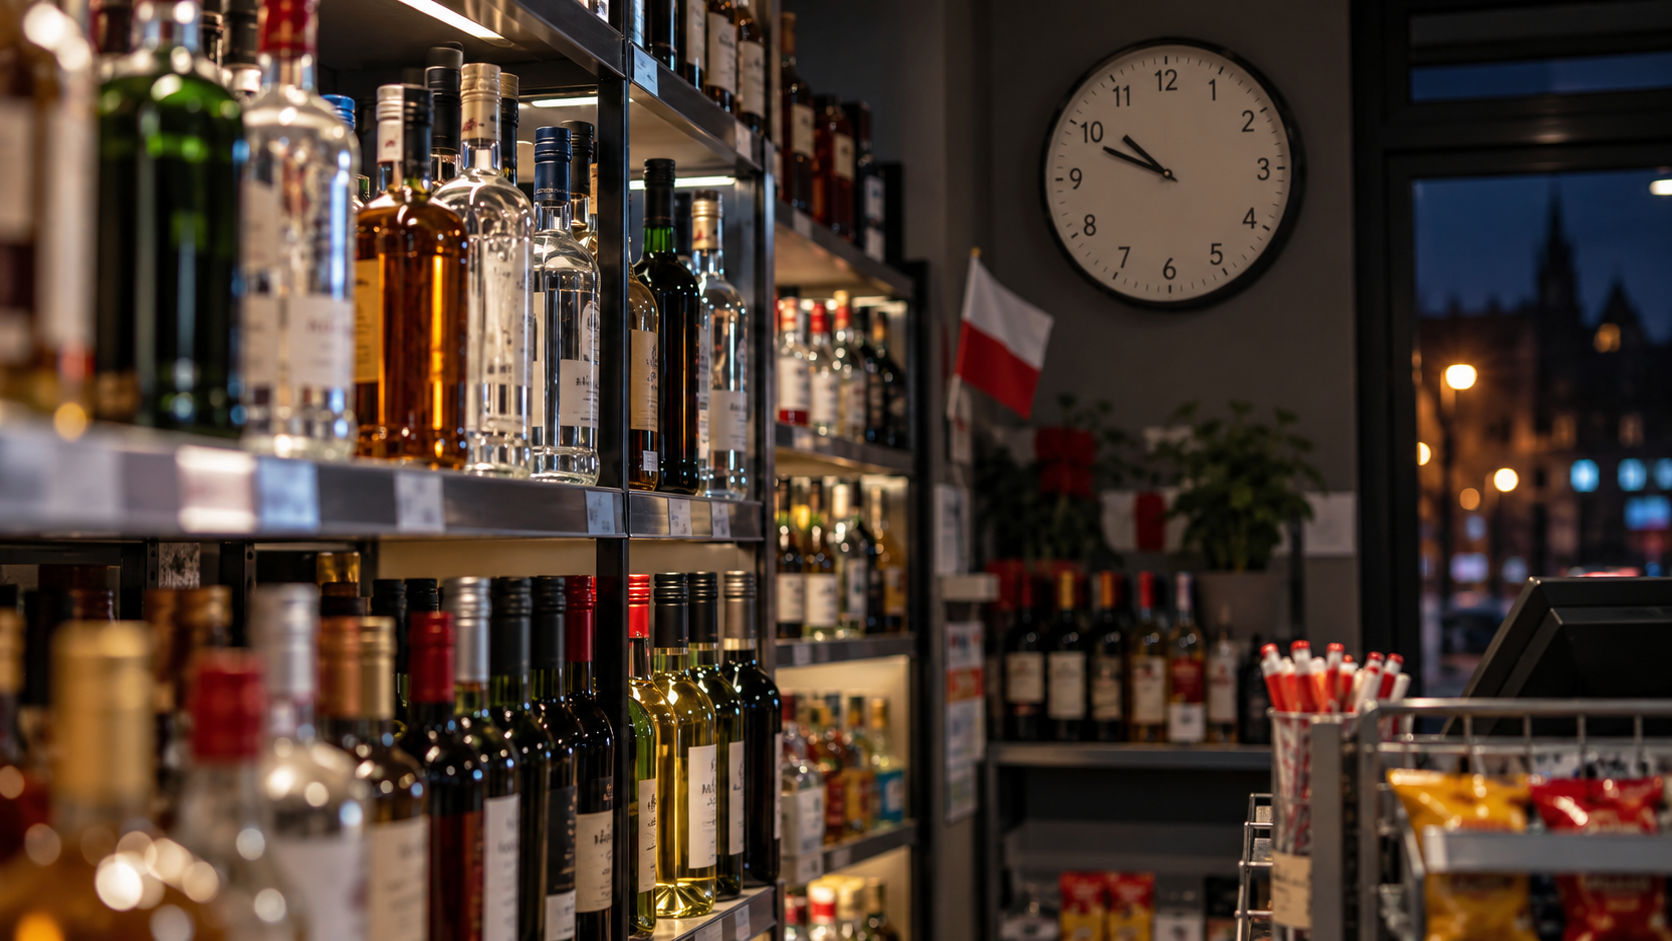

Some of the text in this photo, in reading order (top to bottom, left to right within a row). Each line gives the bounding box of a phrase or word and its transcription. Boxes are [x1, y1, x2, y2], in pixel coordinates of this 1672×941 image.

[1155, 69, 1177, 91] 12
[1208, 79, 1216, 101] 1
[1113, 85, 1129, 107] 11
[1081, 121, 1103, 143] 10
[1242, 110, 1254, 132] 2
[1070, 168, 1082, 189] 9
[1257, 158, 1270, 180] 3
[1084, 214, 1096, 236] 8
[1243, 208, 1257, 229] 4
[1118, 247, 1130, 268] 7
[1210, 243, 1223, 265] 5
[1163, 258, 1176, 280] 6
